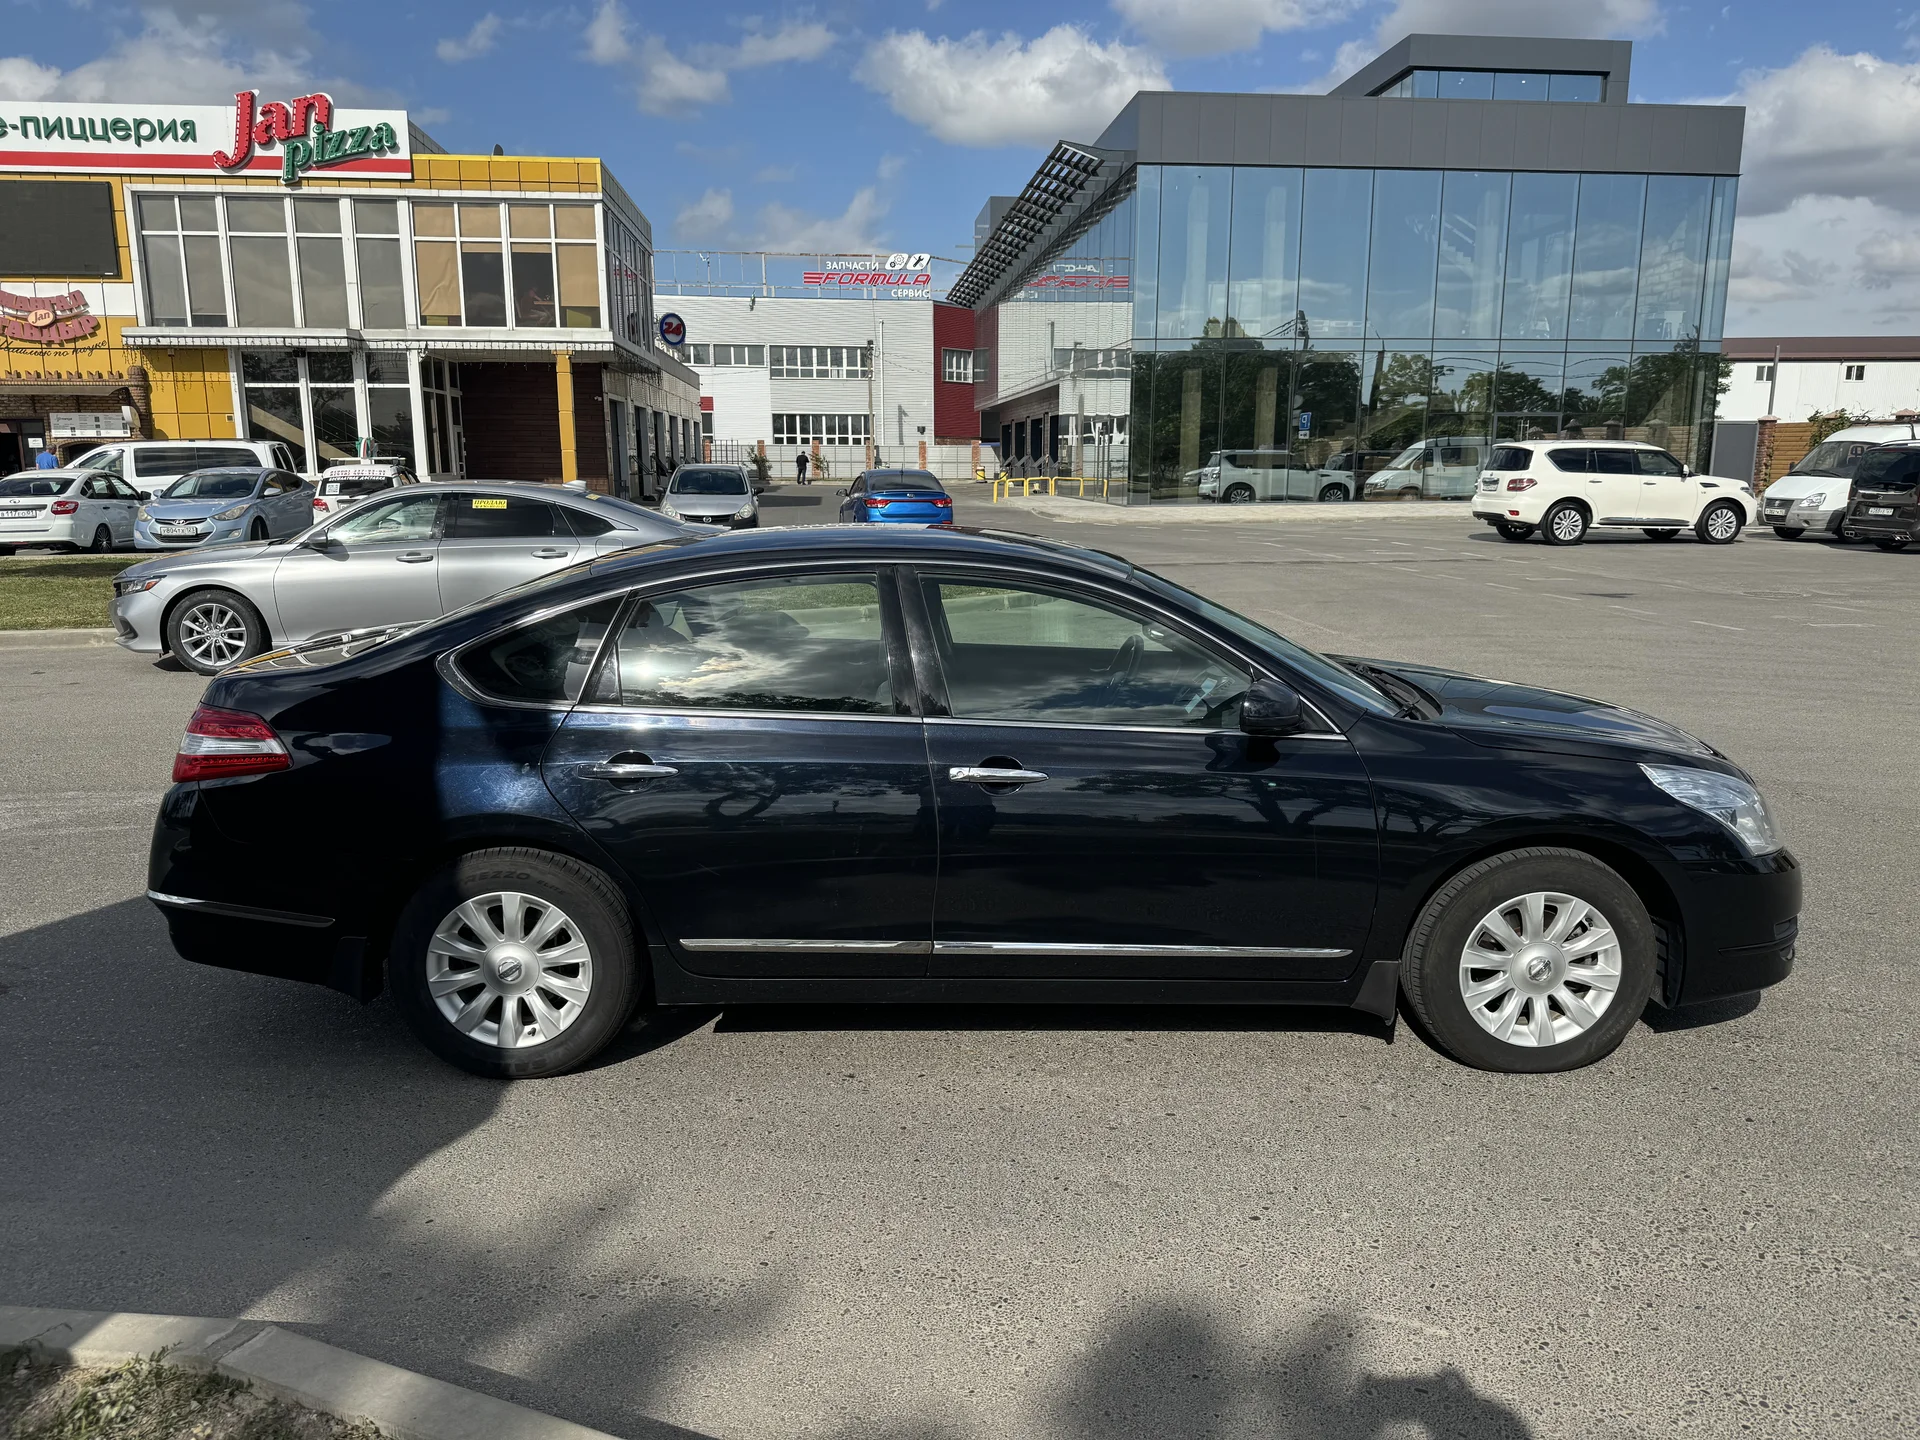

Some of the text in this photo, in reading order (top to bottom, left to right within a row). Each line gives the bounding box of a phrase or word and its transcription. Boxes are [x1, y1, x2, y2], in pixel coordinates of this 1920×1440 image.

[213, 89, 332, 169] Jan
[281, 121, 397, 184] pizza
[826, 261, 879, 270] ЗАПЧАСТИ
[822, 272, 931, 286] FORMULA
[891, 289, 930, 298] СЕРВИС
[32, 311, 51, 324] Jan
[664, 321, 683, 336] 24
